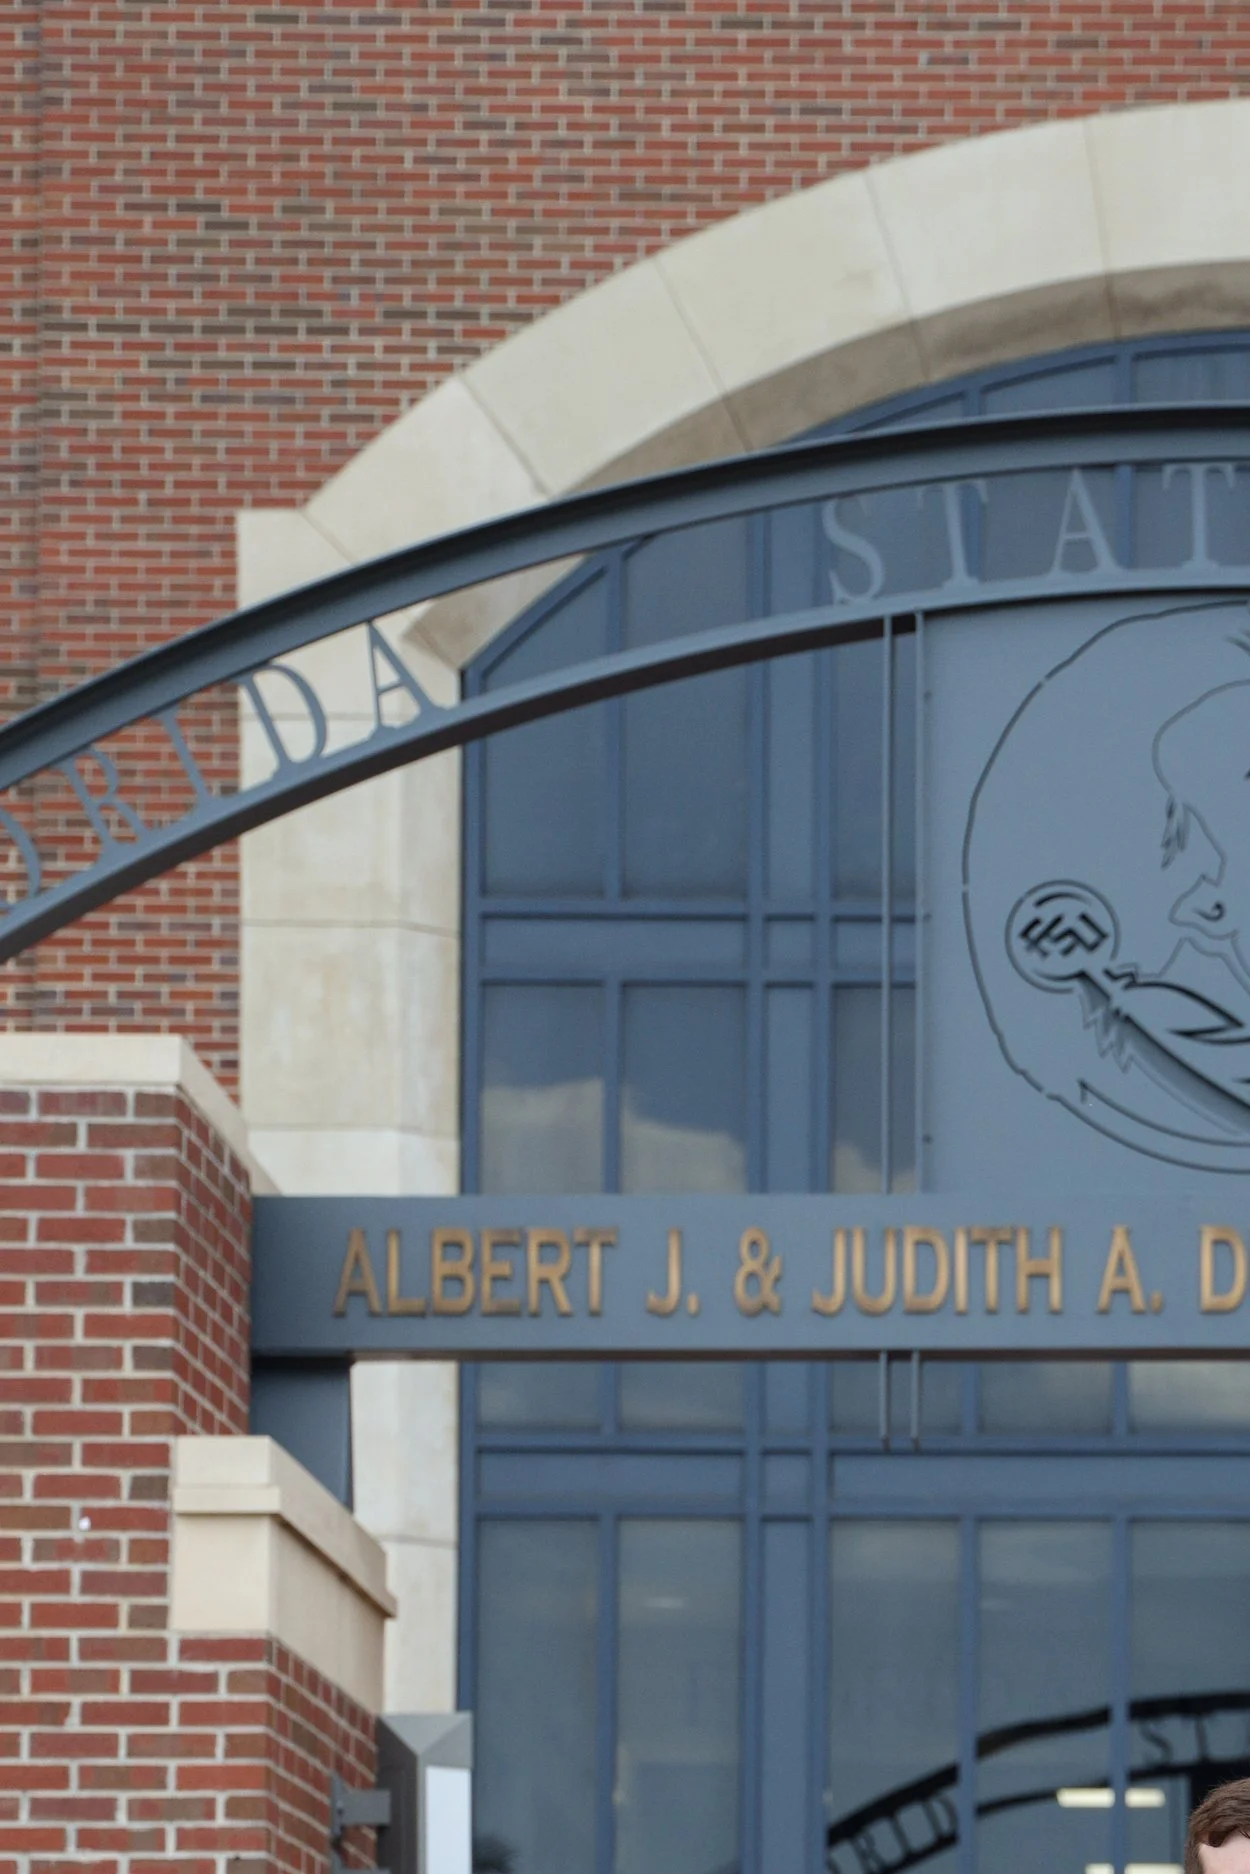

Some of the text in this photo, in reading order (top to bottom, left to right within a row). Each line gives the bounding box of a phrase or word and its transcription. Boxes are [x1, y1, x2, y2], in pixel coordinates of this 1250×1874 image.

[332, 1226, 618, 1317] ALBERT
[647, 1226, 699, 1316] J.
[734, 1226, 783, 1318] &
[812, 1225, 1063, 1316] JUDITH
[1097, 1225, 1163, 1314] A.
